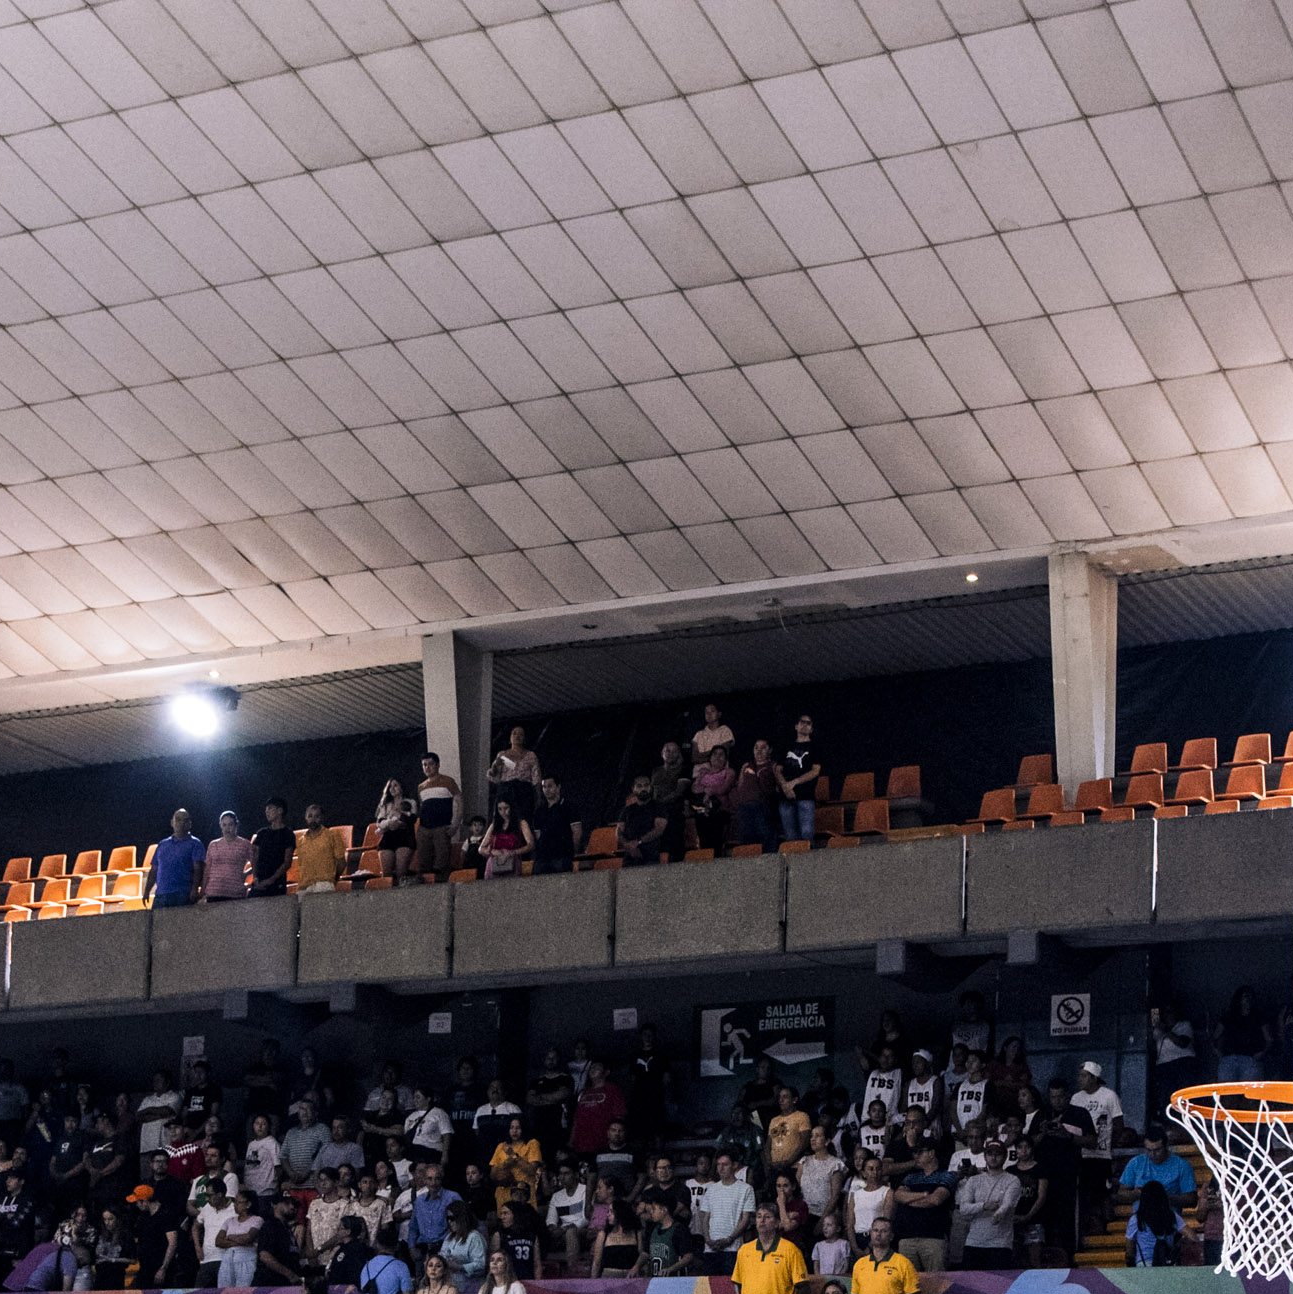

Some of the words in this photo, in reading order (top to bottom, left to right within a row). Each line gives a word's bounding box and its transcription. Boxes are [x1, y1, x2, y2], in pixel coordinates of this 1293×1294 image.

[766, 1004, 802, 1017] SALIDA
[806, 1003, 818, 1015] DE
[759, 1015, 826, 1031] EMERGENCIA
[871, 1077, 895, 1089] TBS
[909, 1091, 930, 1103] TBS
[960, 1091, 982, 1102] TBS
[691, 1187, 707, 1196] TB
[515, 1245, 530, 1260] 33
